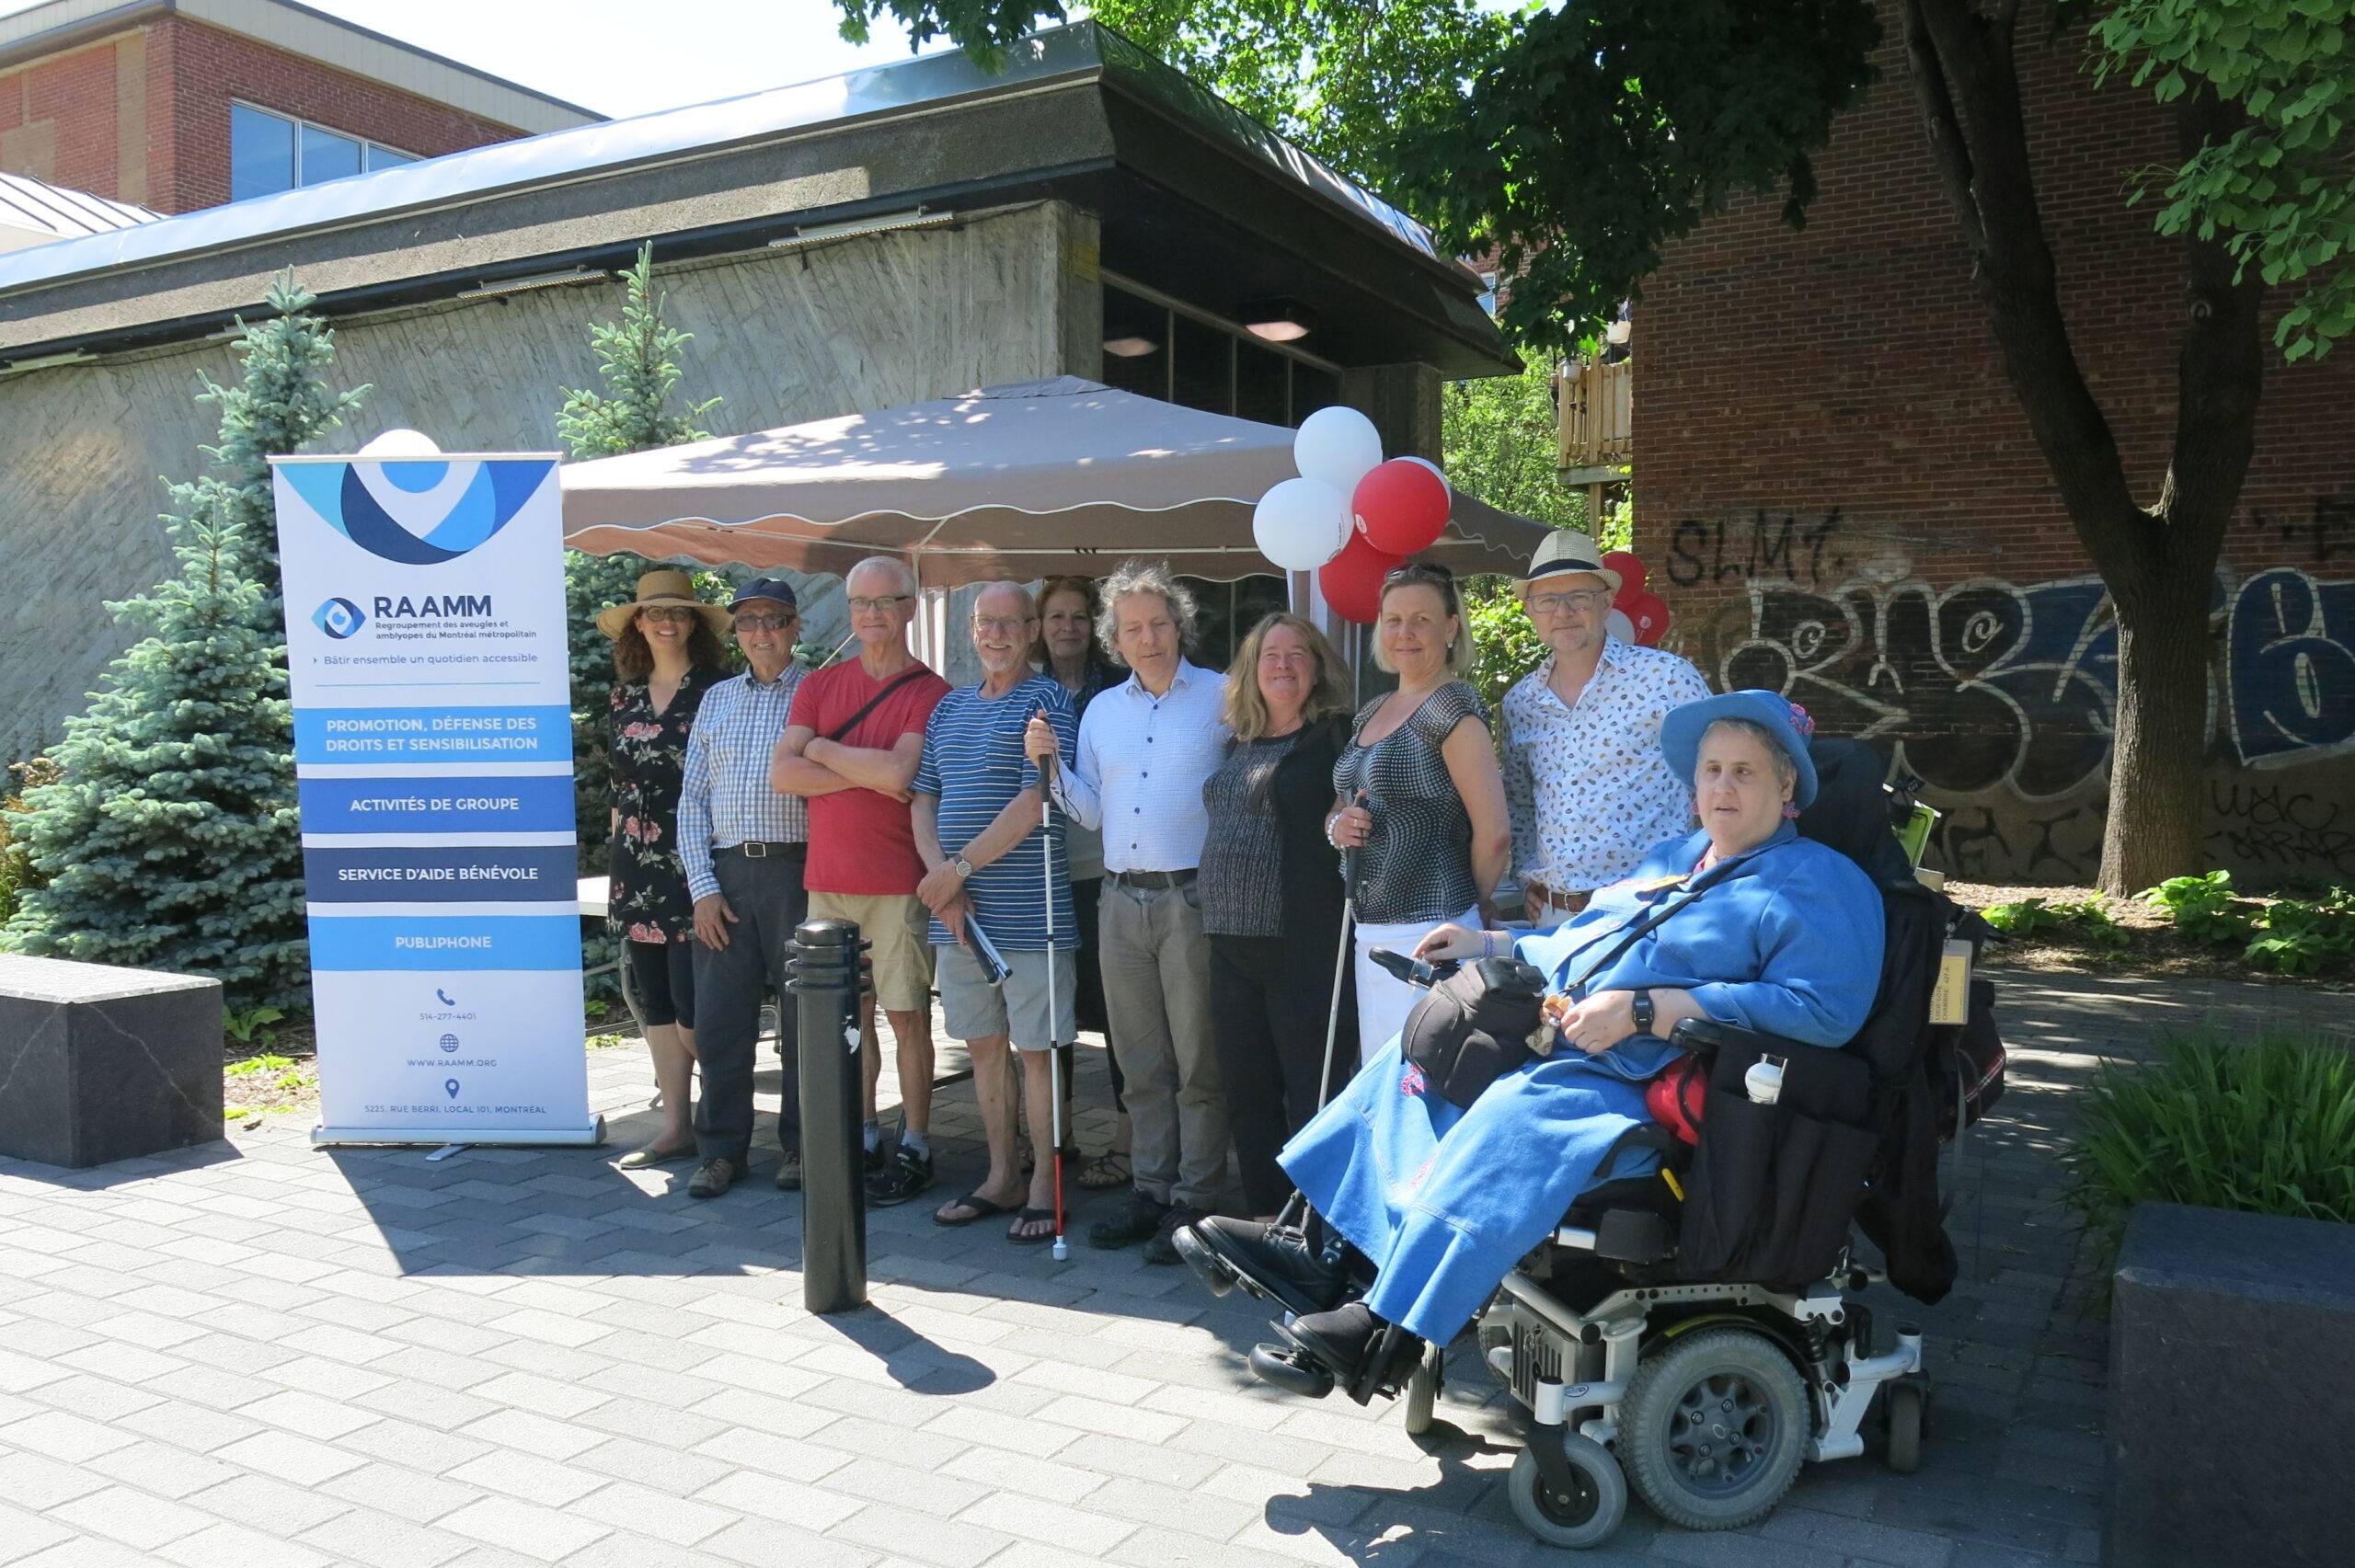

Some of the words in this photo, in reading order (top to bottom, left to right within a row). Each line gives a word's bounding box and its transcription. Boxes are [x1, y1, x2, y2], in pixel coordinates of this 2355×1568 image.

[373, 594, 492, 619] RAAMM
[375, 621, 441, 631] Regroupement
[459, 621, 498, 630] aveugles
[375, 632, 423, 641] amblyopes
[425, 631, 437, 639] du
[439, 631, 477, 639] Montréal
[478, 629, 537, 640] métropolitain
[324, 655, 350, 665] Bâtir
[352, 654, 407, 665] ensemble
[409, 655, 425, 664] un
[427, 653, 479, 665] quotidien
[482, 652, 538, 663] accessible
[326, 718, 428, 733] PROMOTION,
[431, 715, 503, 732] DÉFENSE
[505, 716, 537, 731] DES
[326, 738, 384, 752] DROITS
[386, 738, 406, 751] ET
[408, 736, 538, 751] SENSIBILISATION
[350, 795, 426, 812] ACTIVITÉS
[430, 798, 453, 811] DE
[455, 797, 520, 811] GROUPE
[338, 867, 403, 882] SERVICE
[458, 864, 539, 881] BÉNÉVOLE
[395, 935, 492, 949] PUBLIPHONE
[419, 1013, 477, 1021] 514-277-4401
[407, 1059, 498, 1068] WWW.RAAMM.ORG
[390, 1105, 408, 1114] RUE
[443, 1105, 474, 1114] LOCAL
